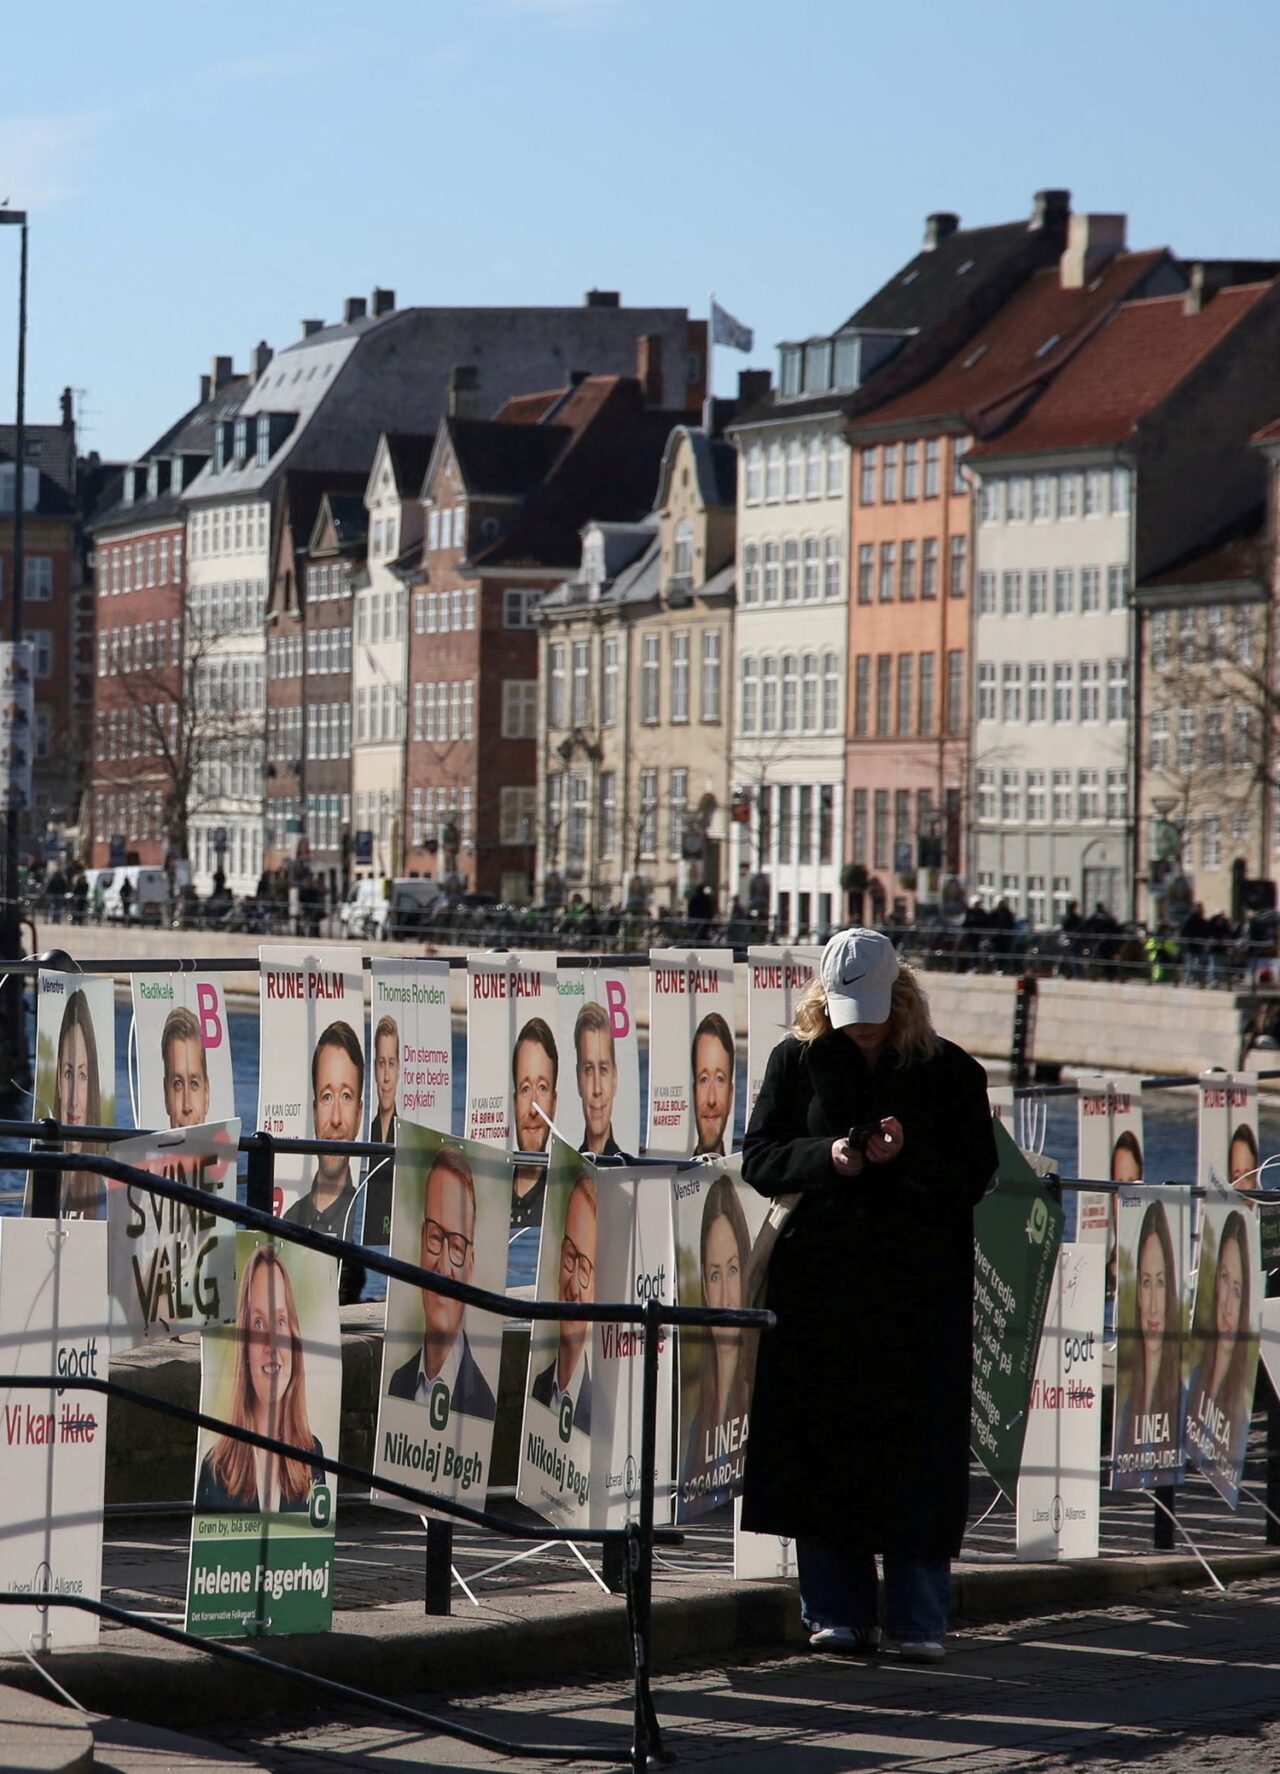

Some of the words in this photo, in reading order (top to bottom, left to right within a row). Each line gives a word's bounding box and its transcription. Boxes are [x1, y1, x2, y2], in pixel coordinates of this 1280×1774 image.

[41, 974, 65, 995] Venstre
[139, 982, 175, 1001] Radikale
[267, 971, 305, 999] RUNE
[308, 972, 345, 1000] PALM
[473, 973, 506, 999] RUNE
[510, 972, 541, 998] PALM
[655, 969, 686, 994] RUNE
[688, 969, 719, 994] PALM
[753, 966, 782, 990] RUNE
[377, 981, 412, 1003] Thomas
[412, 983, 446, 1005] Rohden
[196, 983, 224, 1050] B
[605, 980, 630, 1039] B
[404, 1045, 417, 1064] Din
[417, 1046, 449, 1064] stemme
[403, 1068, 415, 1086] for
[415, 1071, 427, 1086] en
[427, 1069, 450, 1087] bedre
[264, 1104, 271, 1117] VI
[272, 1104, 284, 1117] KAN
[284, 1103, 301, 1117] GODT
[403, 1089, 437, 1111] psykiatri
[1083, 1095, 1106, 1117] RUNE
[1107, 1093, 1131, 1115] PALM
[1203, 1089, 1224, 1109] RUNE
[1226, 1088, 1248, 1108] PALM
[263, 1117, 273, 1133] FÅ
[273, 1119, 284, 1132] TID
[673, 1179, 701, 1201] Venstre
[131, 1235, 221, 1325] VALG
[991, 1267, 1016, 1313] tredje
[992, 1308, 1007, 1339] sig
[601, 1323, 613, 1360] Vi
[615, 1323, 637, 1359] kan
[982, 1325, 1001, 1361] skat
[999, 1351, 1013, 1376] på
[1065, 1330, 1095, 1375] godt
[57, 1336, 98, 1396] godt
[981, 1358, 993, 1379] af
[1042, 1379, 1065, 1409] kan
[1067, 1378, 1094, 1409] ikke
[5, 1404, 22, 1445] Vi
[26, 1404, 56, 1444] kan
[60, 1403, 97, 1444] ikke
[1134, 1413, 1170, 1445] LINEA
[1197, 1390, 1231, 1451] LINEA
[704, 1413, 750, 1464] LINEA
[383, 1431, 442, 1483] Nikolaj
[442, 1446, 483, 1490] Bøgh
[526, 1432, 568, 1493] Nikolaj
[682, 1456, 746, 1504] SØGAARD-LI
[315, 1494, 327, 1520] C
[1064, 1508, 1086, 1522] Alliance
[198, 1520, 216, 1534] Grøn
[218, 1519, 230, 1536] by,
[230, 1518, 243, 1533] blå
[244, 1521, 261, 1533] søer
[193, 1564, 251, 1596] Helene
[254, 1560, 330, 1600] Fagerhøj
